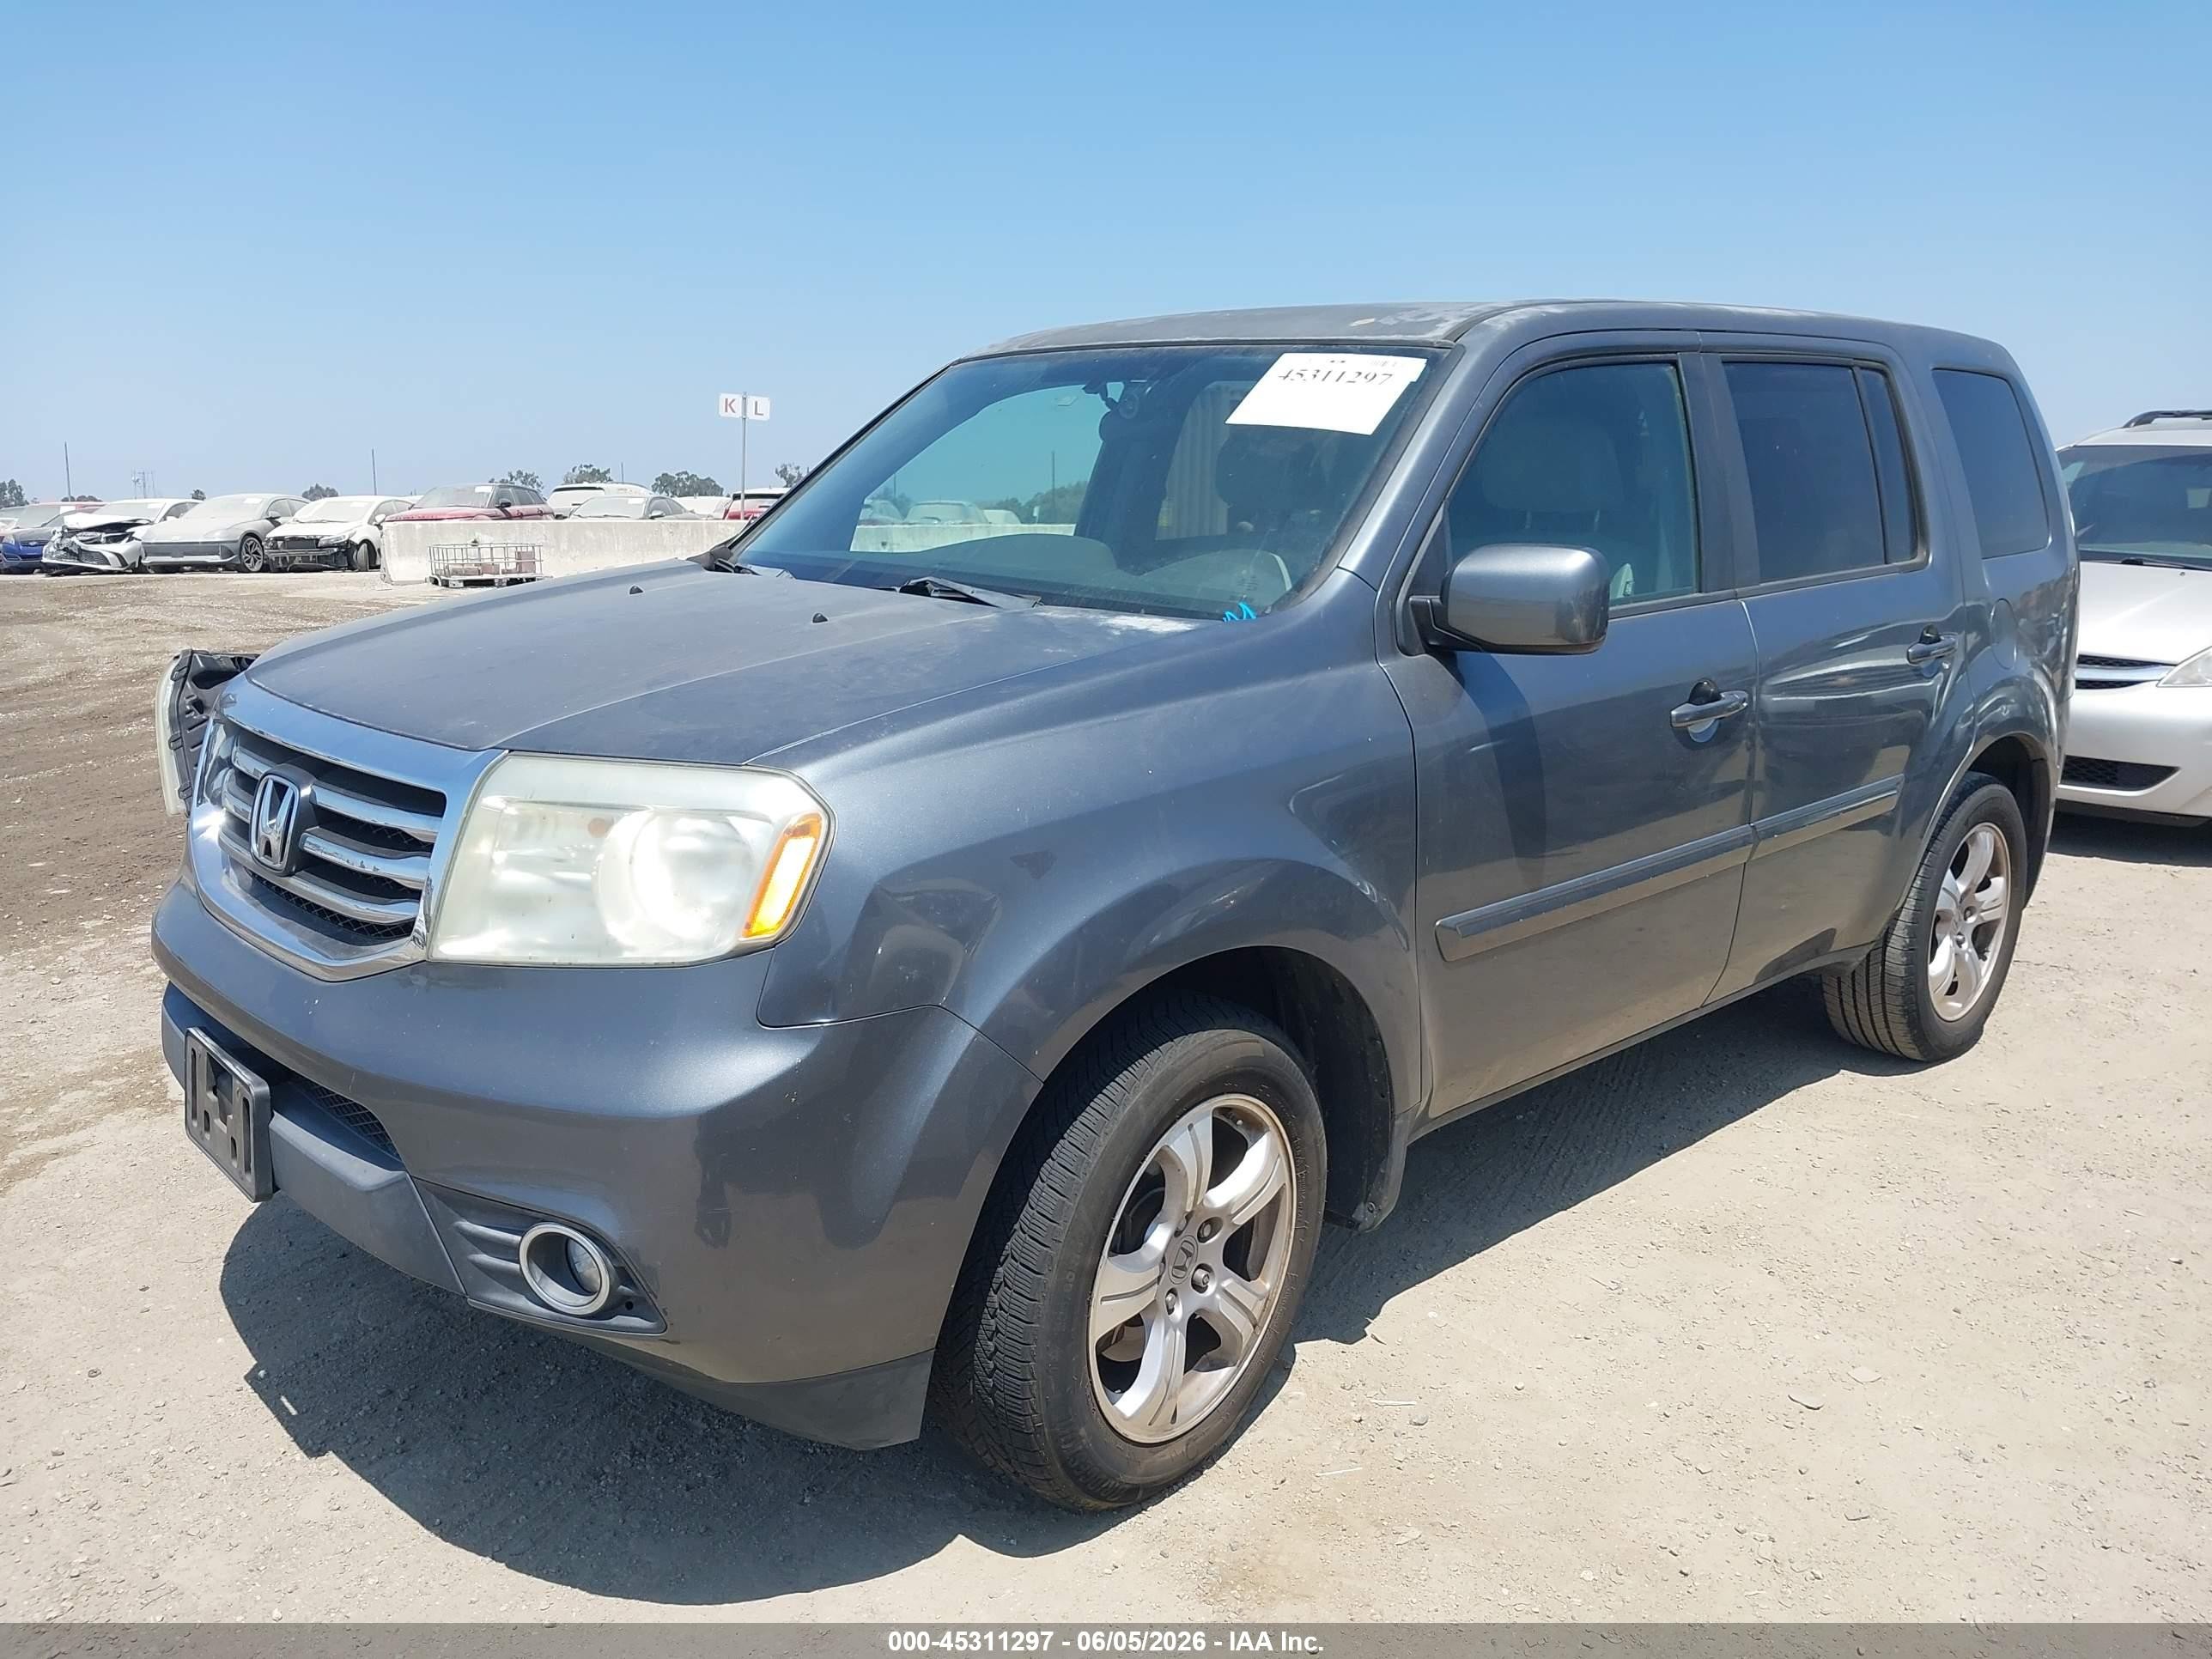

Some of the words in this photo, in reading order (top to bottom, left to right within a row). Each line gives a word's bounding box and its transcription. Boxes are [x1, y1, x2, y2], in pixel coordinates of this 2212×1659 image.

[1278, 368, 1394, 386] 45311297
[725, 398, 736, 414] K
[754, 400, 764, 416] L
